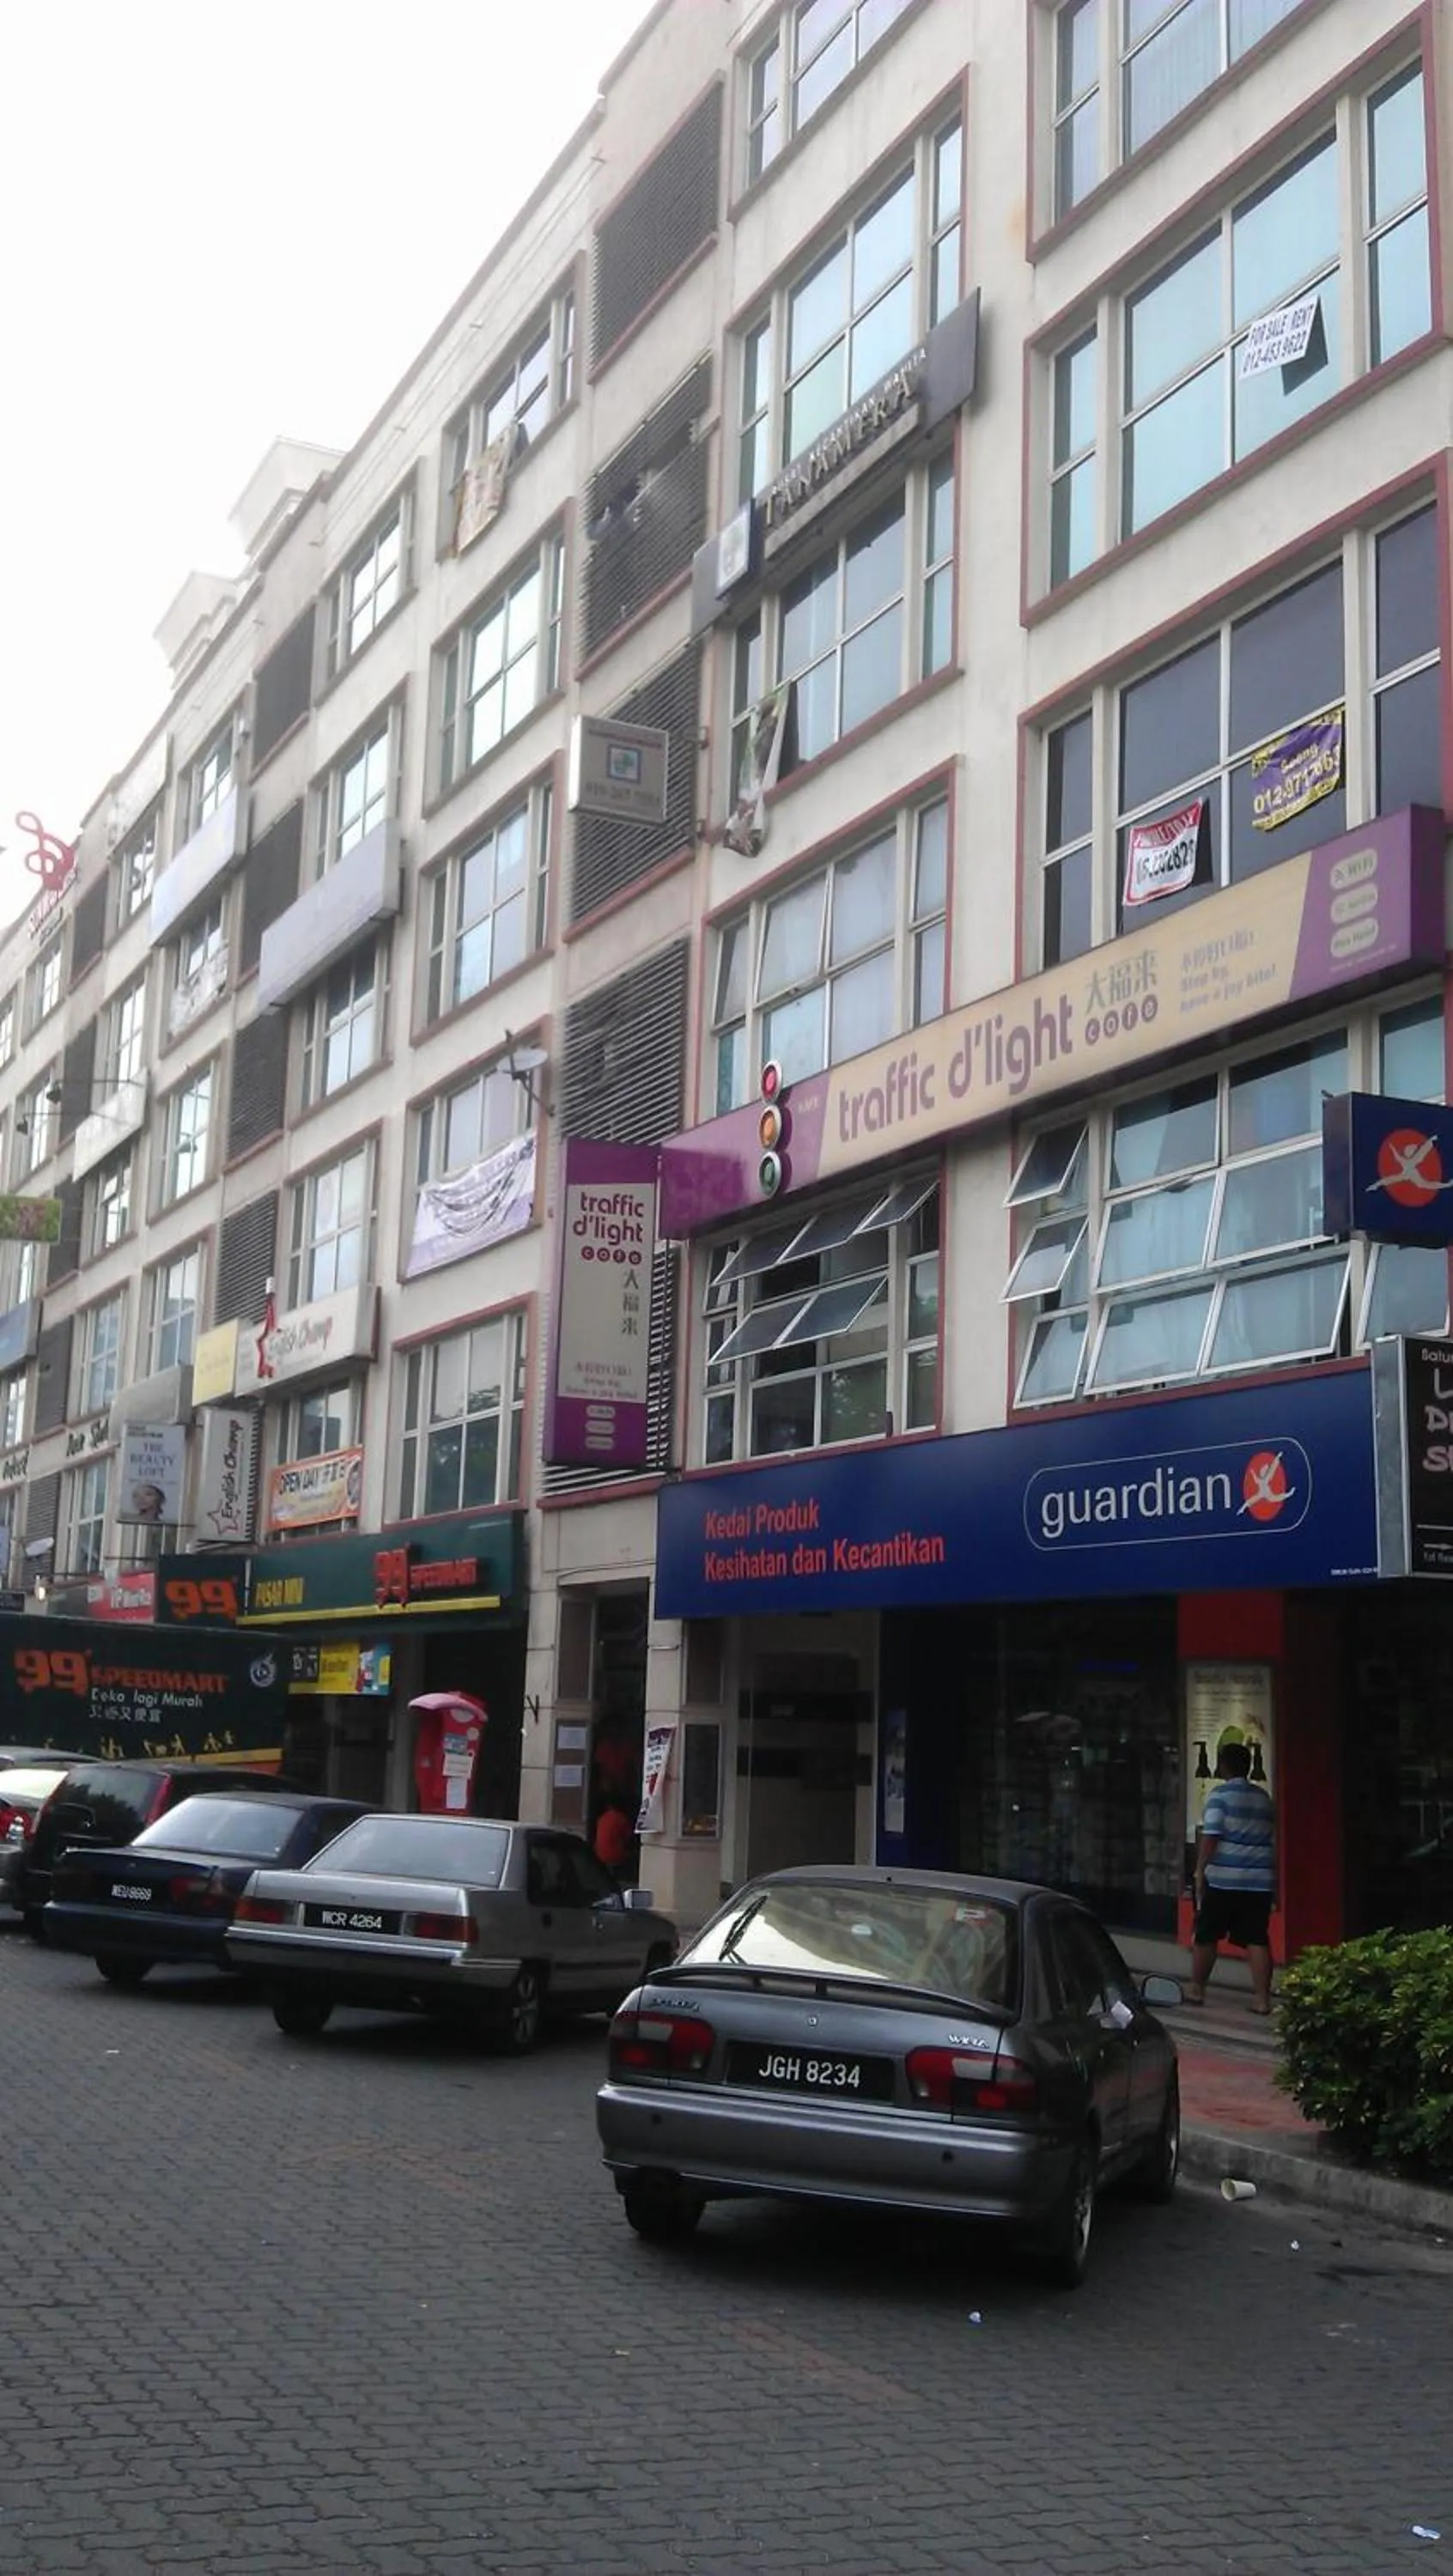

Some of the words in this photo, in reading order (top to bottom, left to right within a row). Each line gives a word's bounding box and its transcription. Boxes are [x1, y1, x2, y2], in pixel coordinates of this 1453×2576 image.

[838, 1057, 936, 1143] traffic
[947, 991, 1073, 1097] d'light
[580, 1191, 644, 1218] traffic
[573, 1215, 644, 1245] d'light
[220, 1470, 238, 1519] English
[1042, 1467, 1232, 1539] guardian
[704, 1509, 751, 1540] Kedai
[756, 1498, 819, 1534] Produk
[704, 1548, 787, 1582] Kesihatan
[792, 1544, 827, 1575] dan
[832, 1534, 945, 1570] Kecantikan
[165, 1579, 237, 1619] 99
[14, 1649, 88, 1697] 99
[90, 1667, 228, 1694] SPEEDMART
[133, 1690, 158, 1709] lagi
[161, 1692, 204, 1709] Murah
[321, 1910, 349, 1927] WCR
[350, 1912, 382, 1929] 4264
[758, 2055, 800, 2083] JGH
[806, 2061, 860, 2088] 8234
